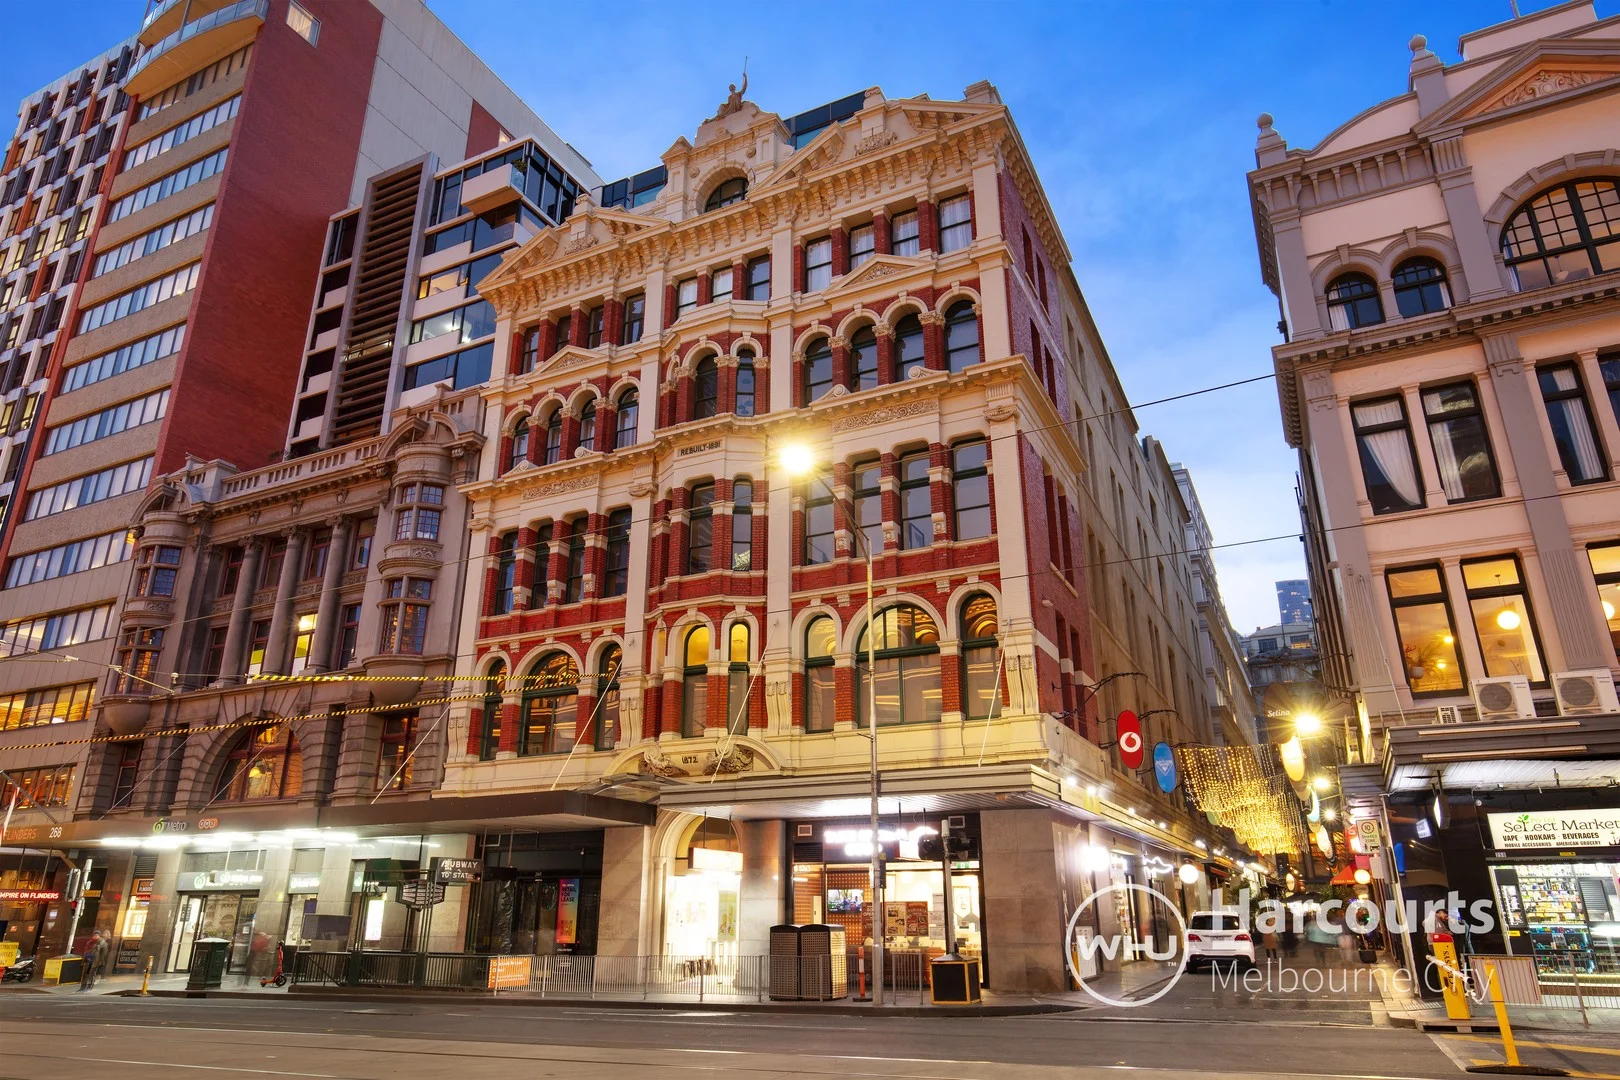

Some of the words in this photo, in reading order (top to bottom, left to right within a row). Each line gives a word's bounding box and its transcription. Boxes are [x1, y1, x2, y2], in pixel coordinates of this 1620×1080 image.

[1267, 709, 1290, 718] Selina
[681, 756, 698, 764] 1872
[166, 821, 187, 832] Metro
[1561, 818, 1620, 831] Market
[49, 826, 62, 838] 268
[1524, 833, 1556, 841] HOOKAHS
[1562, 832, 1600, 840] BEVERAGES
[444, 860, 478, 869] SUBWAY
